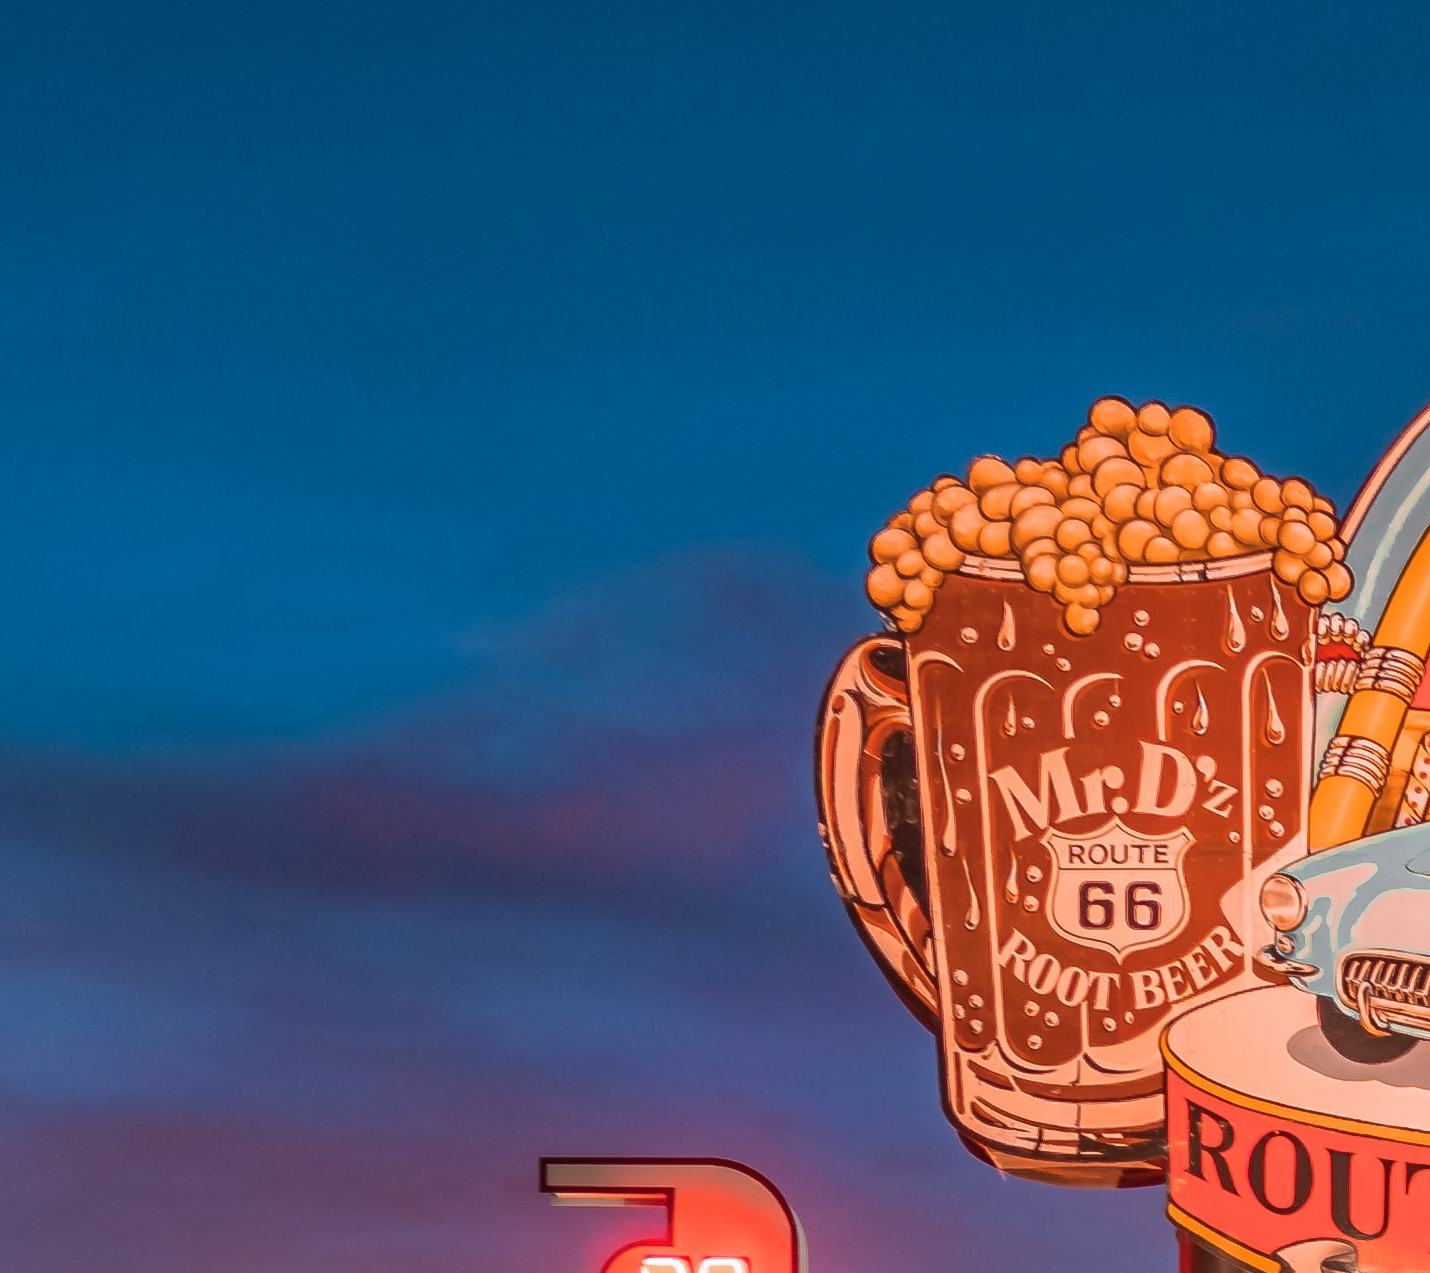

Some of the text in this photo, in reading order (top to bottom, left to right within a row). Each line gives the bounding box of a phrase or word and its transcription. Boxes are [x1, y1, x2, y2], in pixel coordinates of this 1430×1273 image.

[988, 746, 1130, 842] Mr.
[1068, 844, 1169, 864] ROUTE
[1079, 881, 1162, 930] 66
[999, 925, 1245, 1011] ROOT BEER
